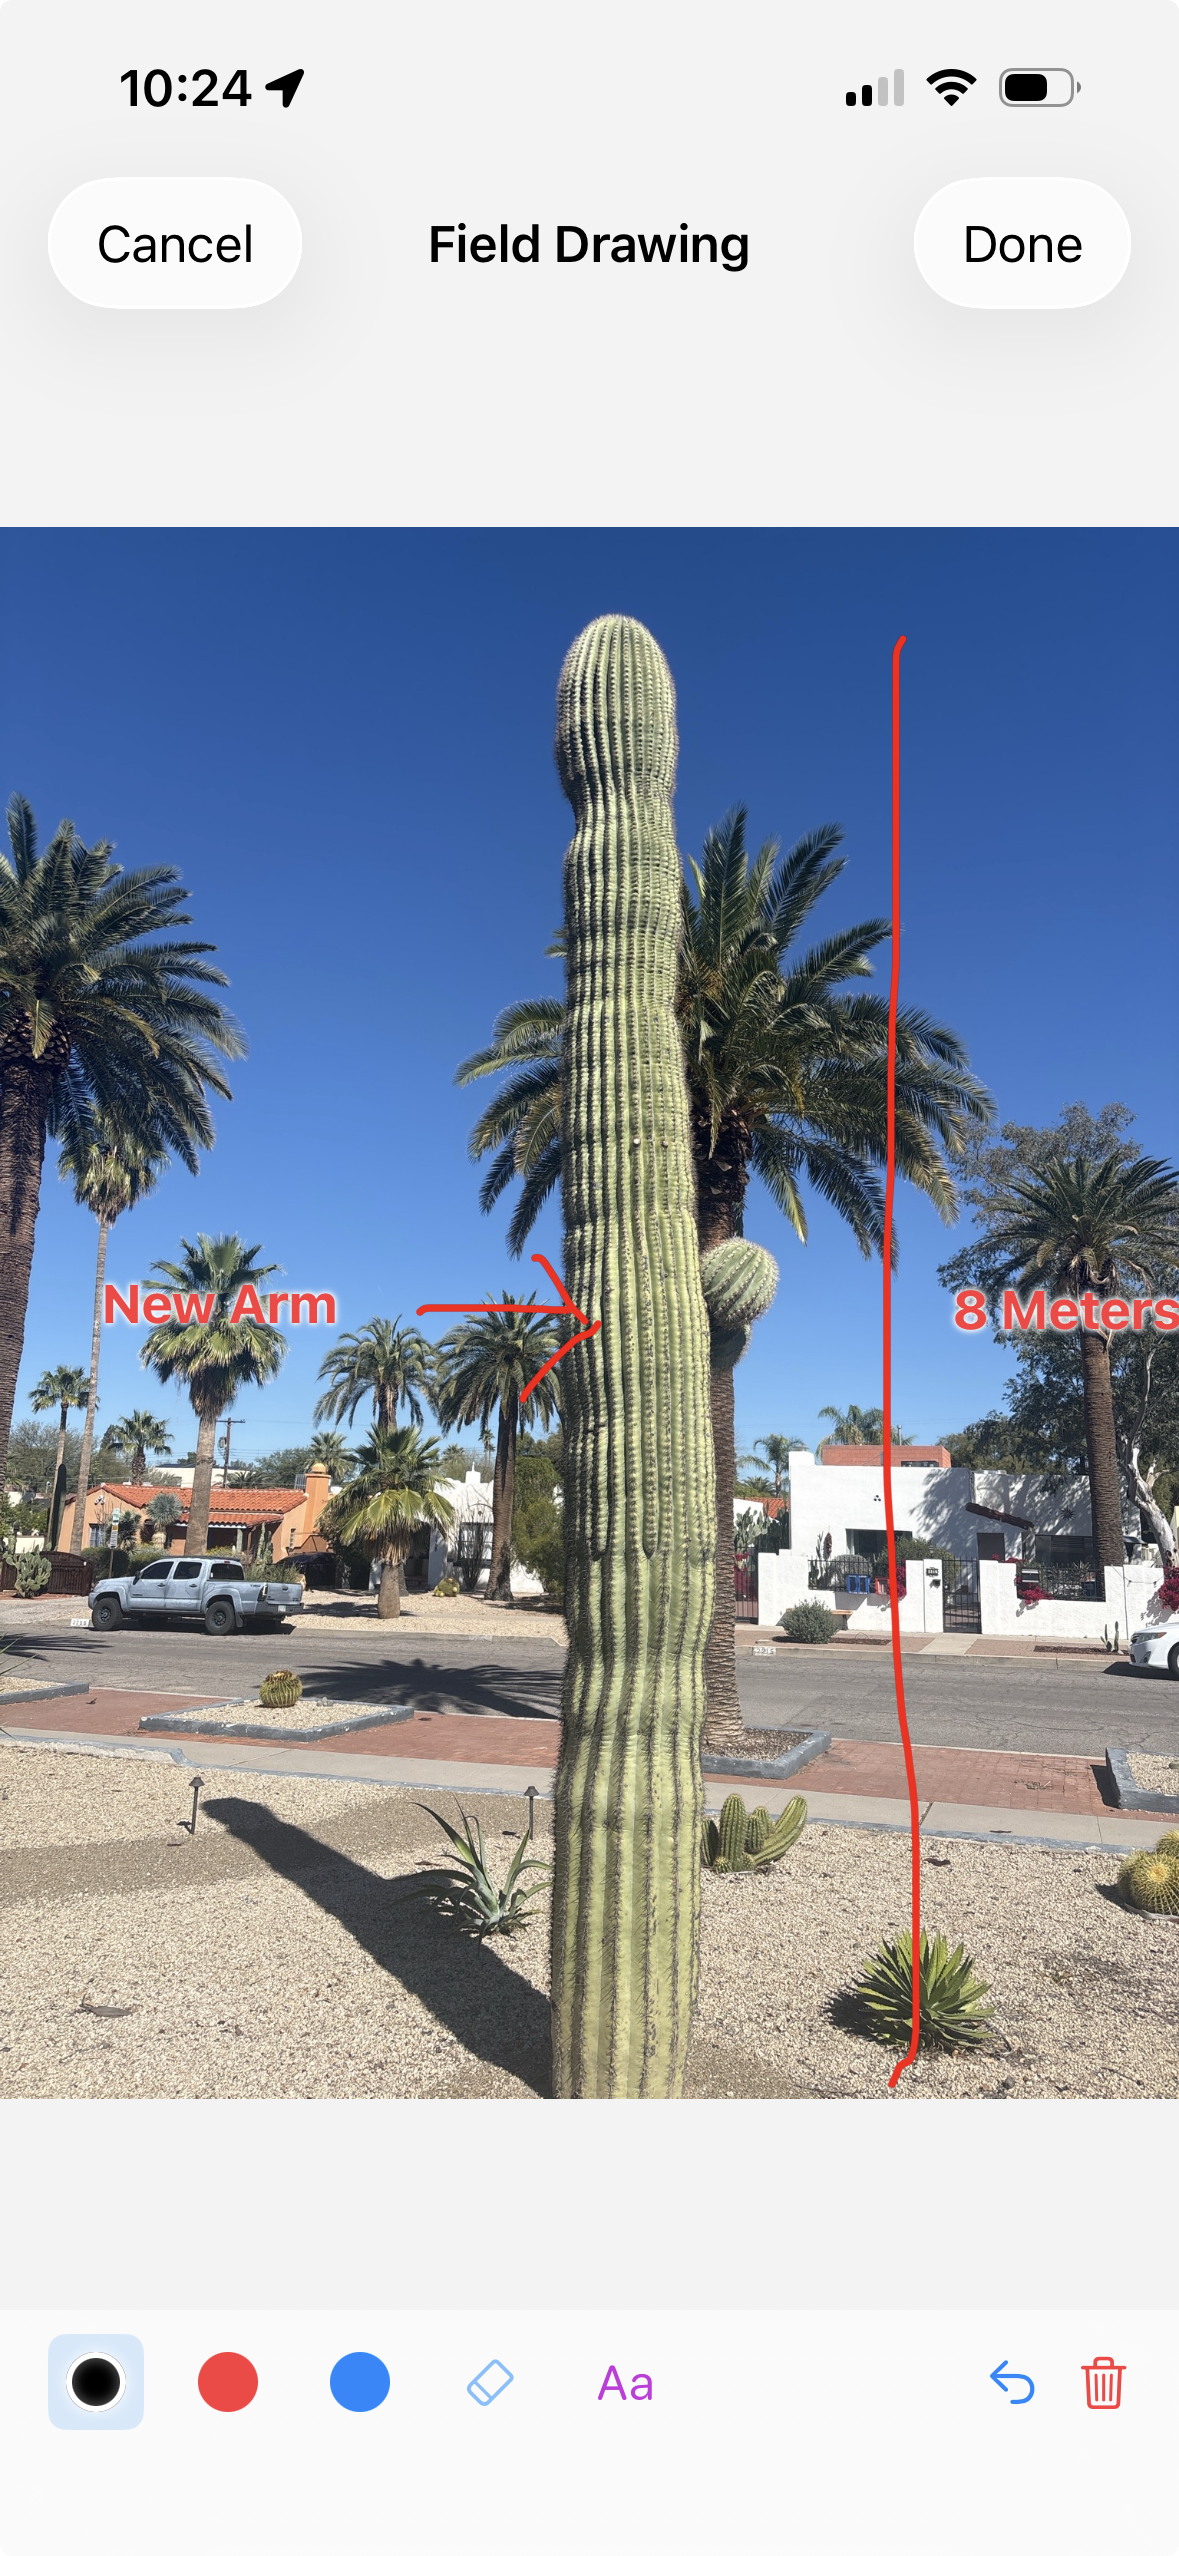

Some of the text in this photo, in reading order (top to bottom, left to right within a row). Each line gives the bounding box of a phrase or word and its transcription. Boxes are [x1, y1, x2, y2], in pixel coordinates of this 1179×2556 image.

[120, 69, 252, 108] 10:24
[98, 223, 252, 264] Cancel
[430, 222, 749, 273] Field Drawing
[966, 225, 1083, 263] Done
[597, 2364, 653, 2401] Aa
